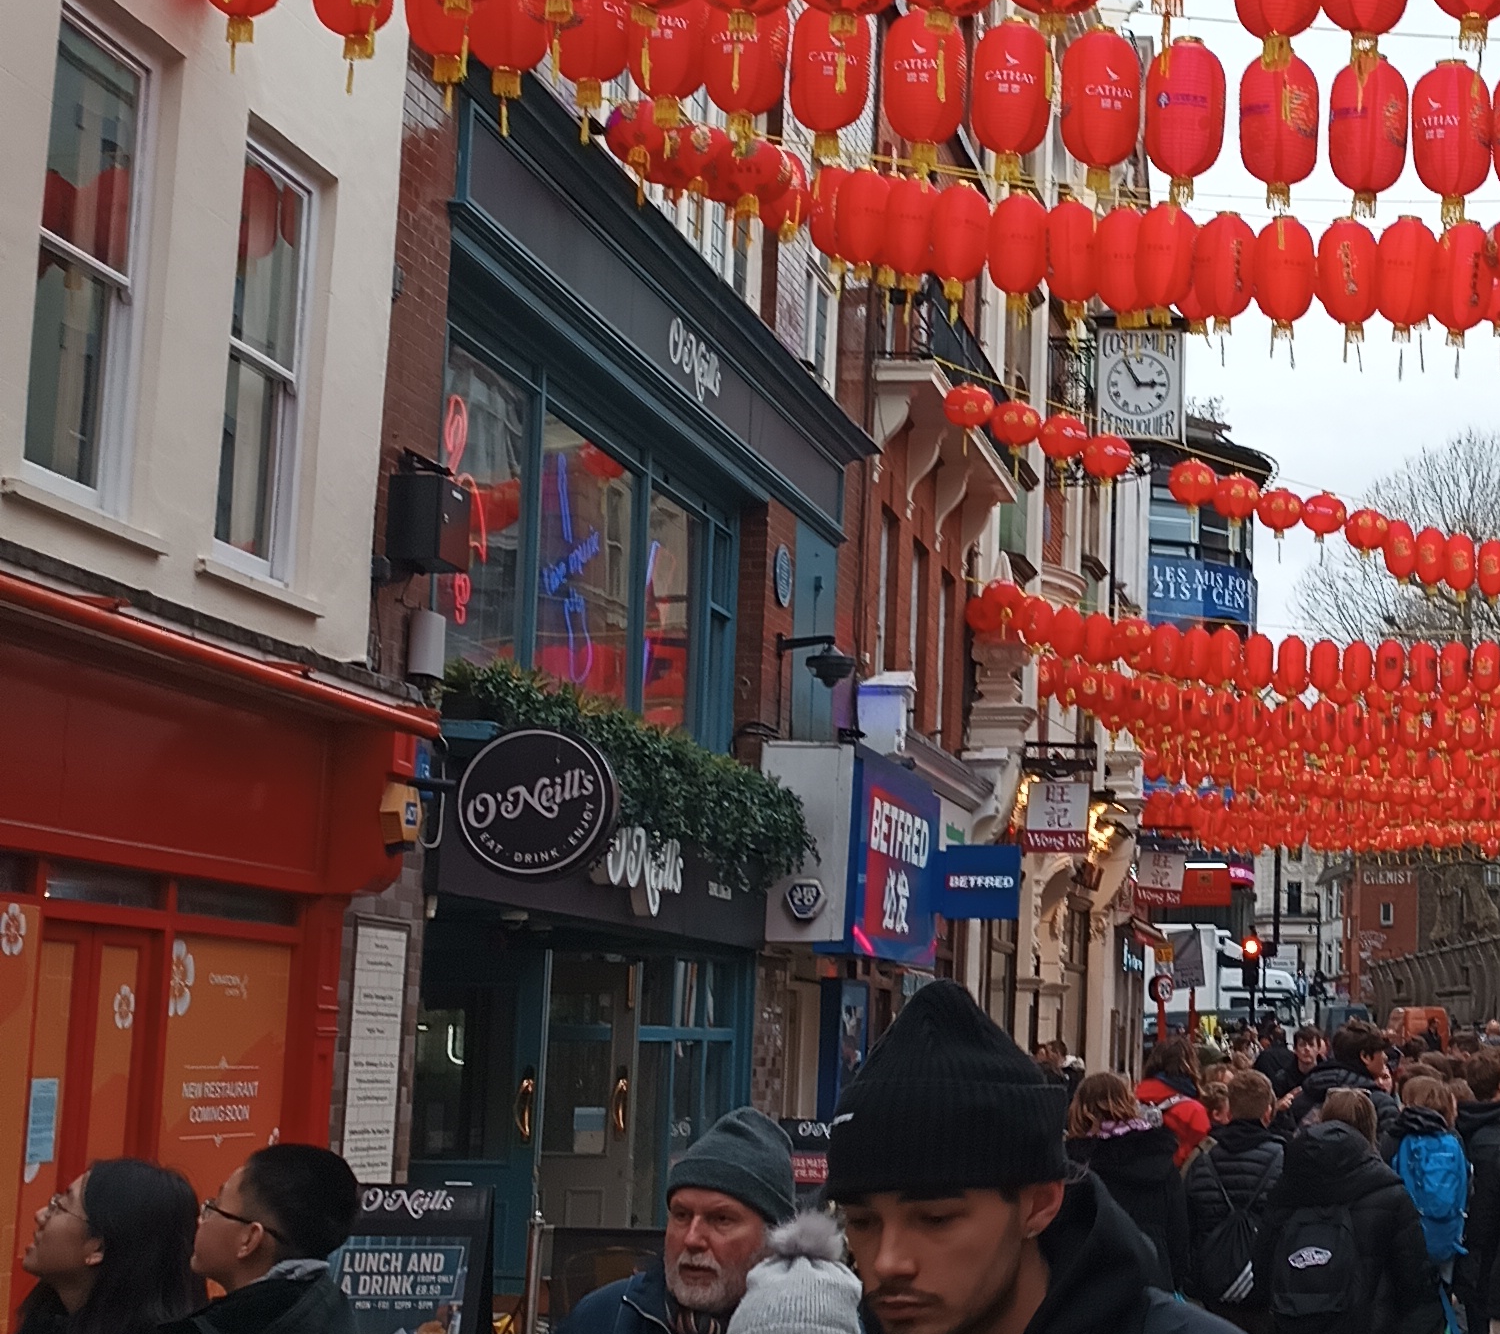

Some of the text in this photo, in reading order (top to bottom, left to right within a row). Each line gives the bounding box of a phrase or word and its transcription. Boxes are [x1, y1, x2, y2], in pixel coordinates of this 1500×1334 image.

[985, 69, 1037, 85] CATHAY
[1085, 83, 1134, 99] CATHAY
[1100, 409, 1176, 438] PERRUQUIER
[1152, 565, 1187, 583] LES
[1152, 581, 1207, 601] 21ST
[466, 768, 595, 829] O'Neill's
[479, 802, 595, 864] EAT DRINK ENJOY
[870, 796, 930, 869] BETFRED
[1027, 831, 1087, 852] Wong Kei
[949, 875, 1015, 889] BETFRED
[1363, 870, 1412, 885] CHEMIST
[1137, 888, 1164, 904] Wong
[182, 1080, 259, 1099] NEW RESTAURANT
[189, 1105, 250, 1123] COMING SOON
[343, 1252, 445, 1273] LUNCH AND
[358, 1275, 415, 1295] DRINK
[355, 1300, 371, 1310] MON
